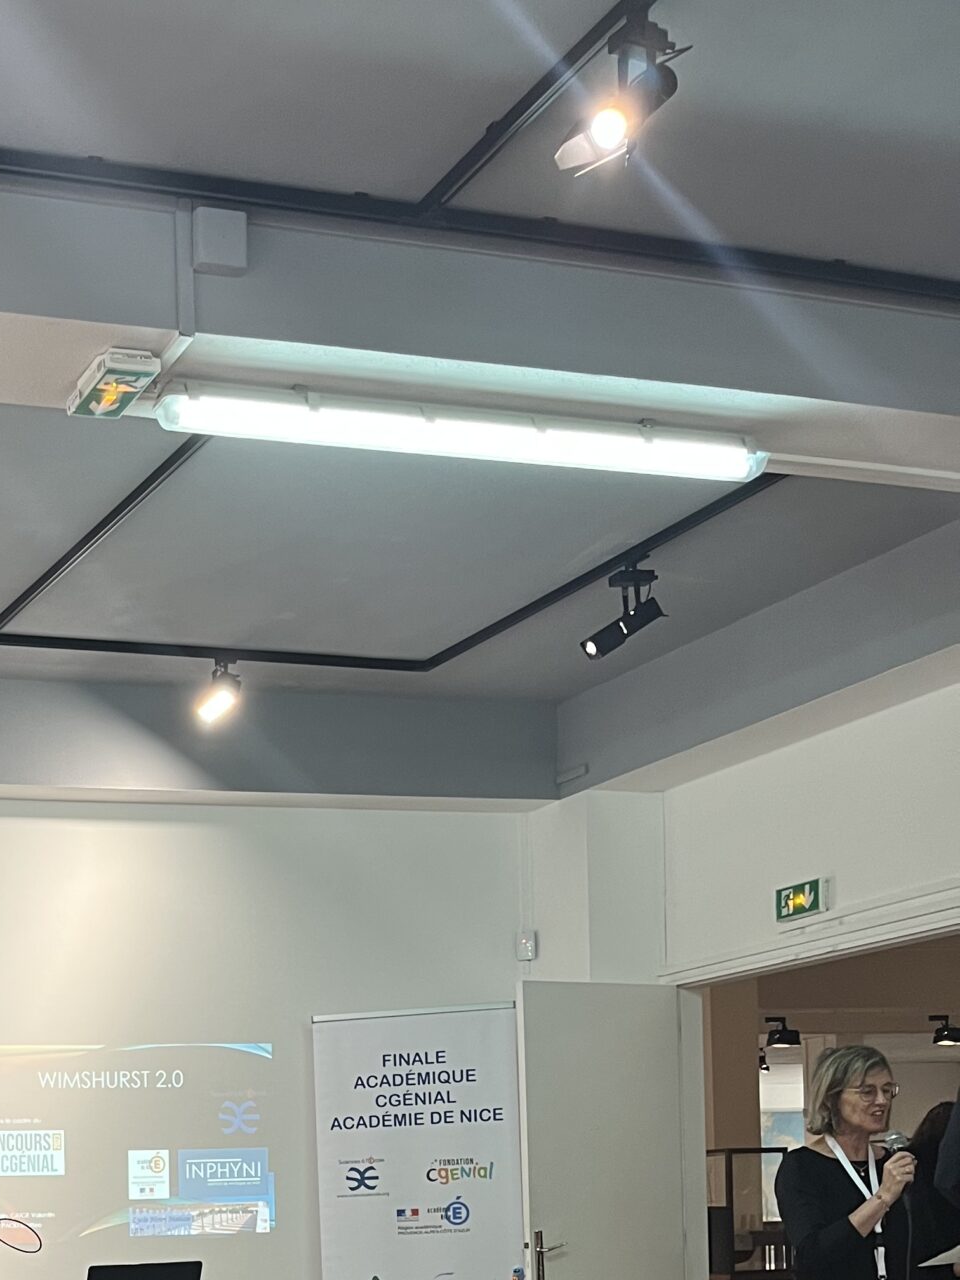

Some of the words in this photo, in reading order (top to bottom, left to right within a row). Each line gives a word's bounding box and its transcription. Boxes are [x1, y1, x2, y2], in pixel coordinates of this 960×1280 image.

[382, 1051, 446, 1067] FINALE
[38, 1071, 151, 1088] WIMSHURST
[156, 1070, 184, 1088] 2.0
[354, 1069, 477, 1089] ACADÉMIQUE
[375, 1090, 456, 1108] CGÉNIAL
[330, 1111, 424, 1130] ACADÉMIE
[430, 1111, 454, 1125] DE
[460, 1108, 504, 1123] NICE
[1, 1150, 58, 1173] CGÉNIAL
[185, 1161, 261, 1179] INPHYNI
[438, 1158, 474, 1166] FONDATION
